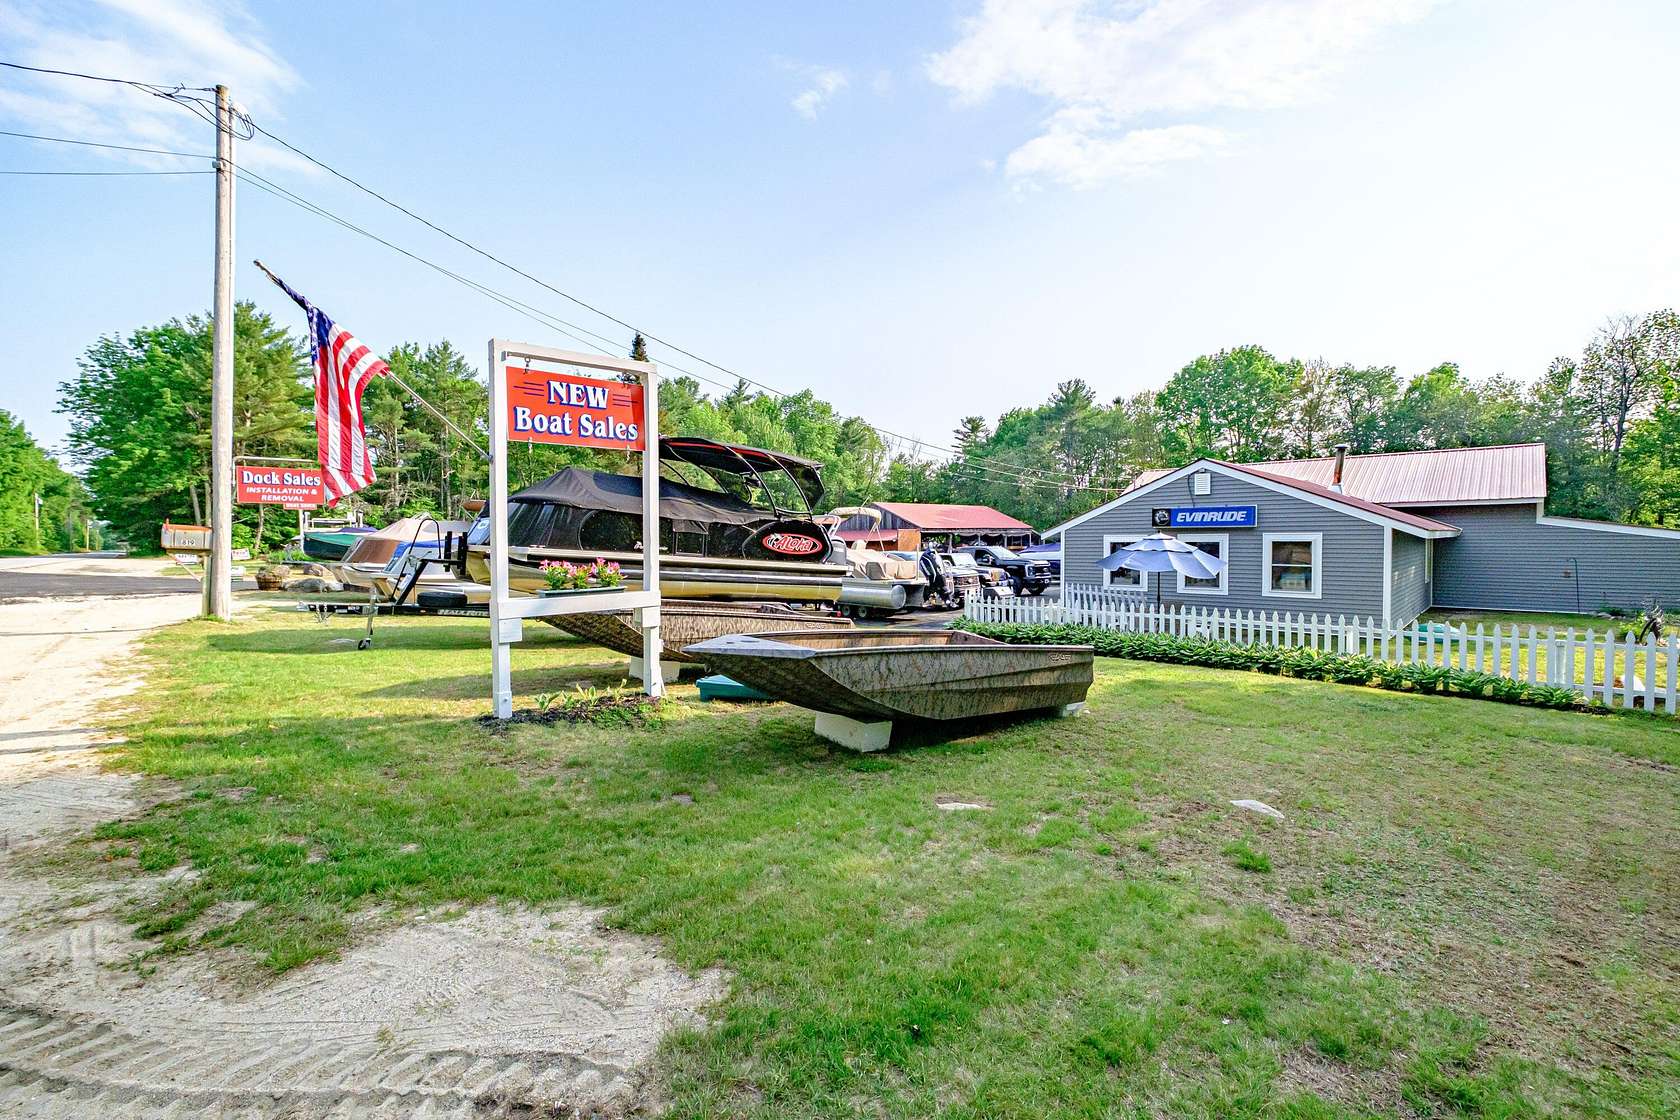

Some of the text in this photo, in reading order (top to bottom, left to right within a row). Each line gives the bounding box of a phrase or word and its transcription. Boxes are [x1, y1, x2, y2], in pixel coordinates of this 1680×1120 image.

[547, 380, 609, 409] NEW
[513, 405, 639, 441] Boat Sales
[242, 470, 321, 486] Dock Sales
[246, 486, 309, 495] INSTALLATION
[261, 494, 304, 502] REMOVAL
[1176, 511, 1248, 523] EVINRUDE
